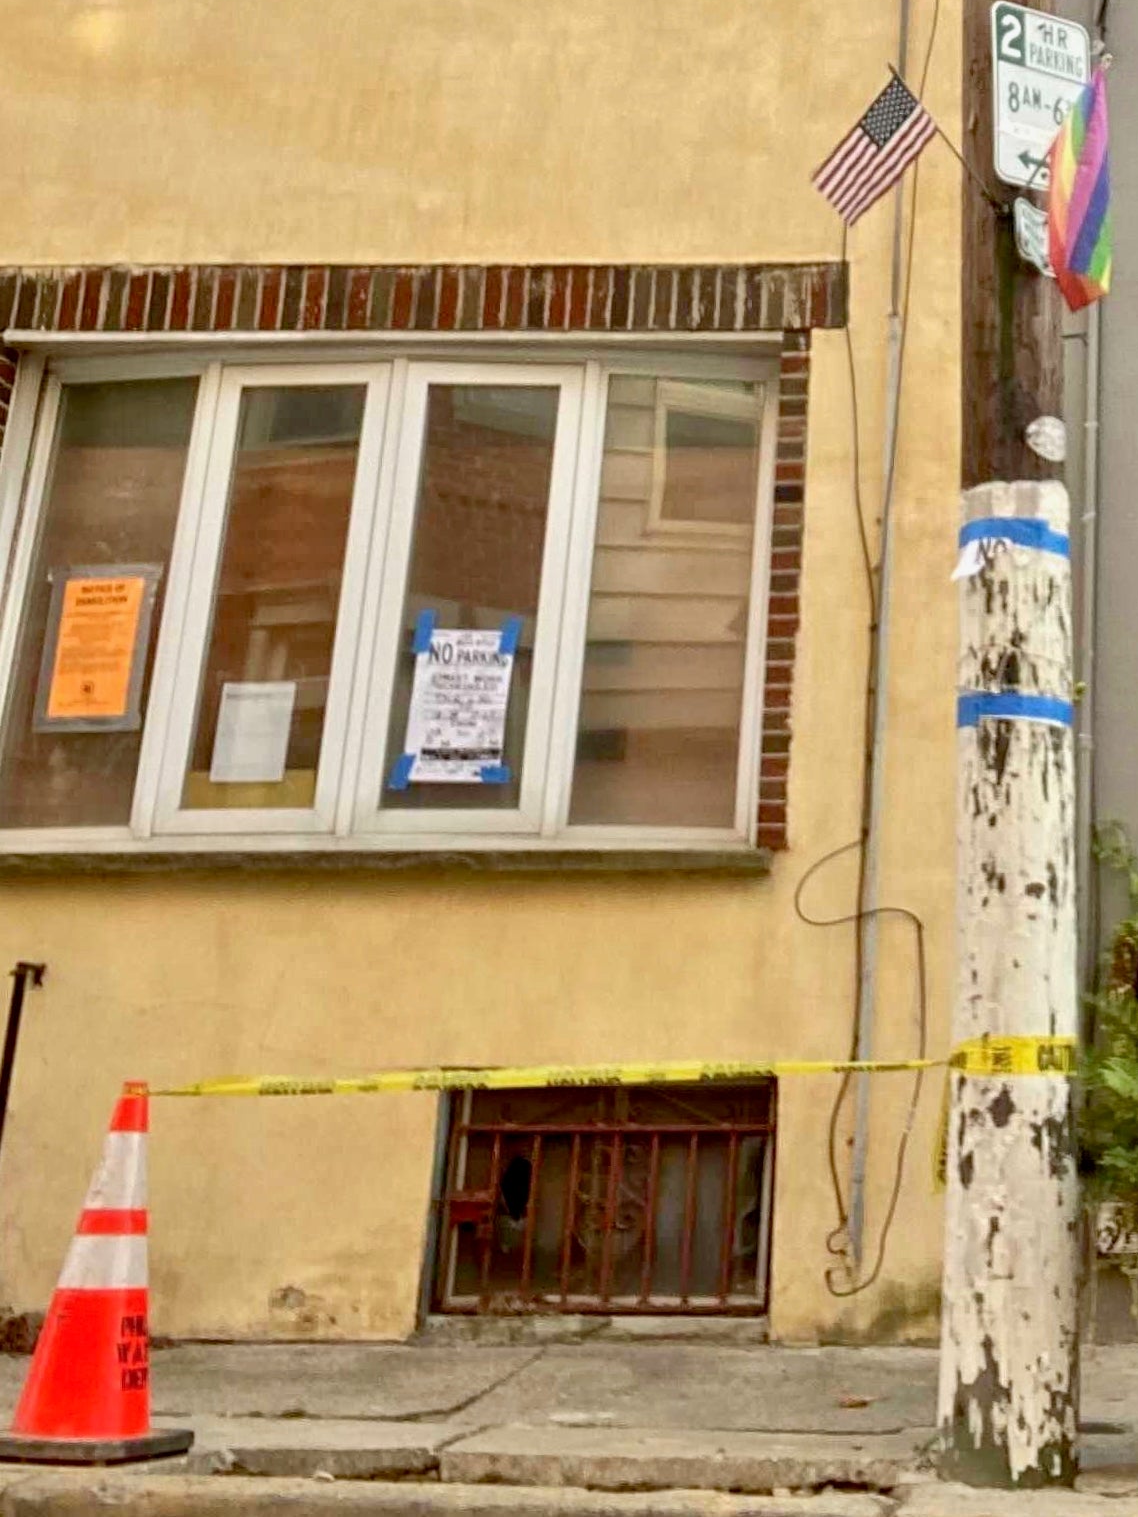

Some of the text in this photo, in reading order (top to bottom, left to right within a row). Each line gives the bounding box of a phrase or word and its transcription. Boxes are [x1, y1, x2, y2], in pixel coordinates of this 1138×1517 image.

[1001, 14, 1068, 59] 2 HR
[1029, 42, 1083, 79] PARKING
[428, 642, 453, 665] NO
